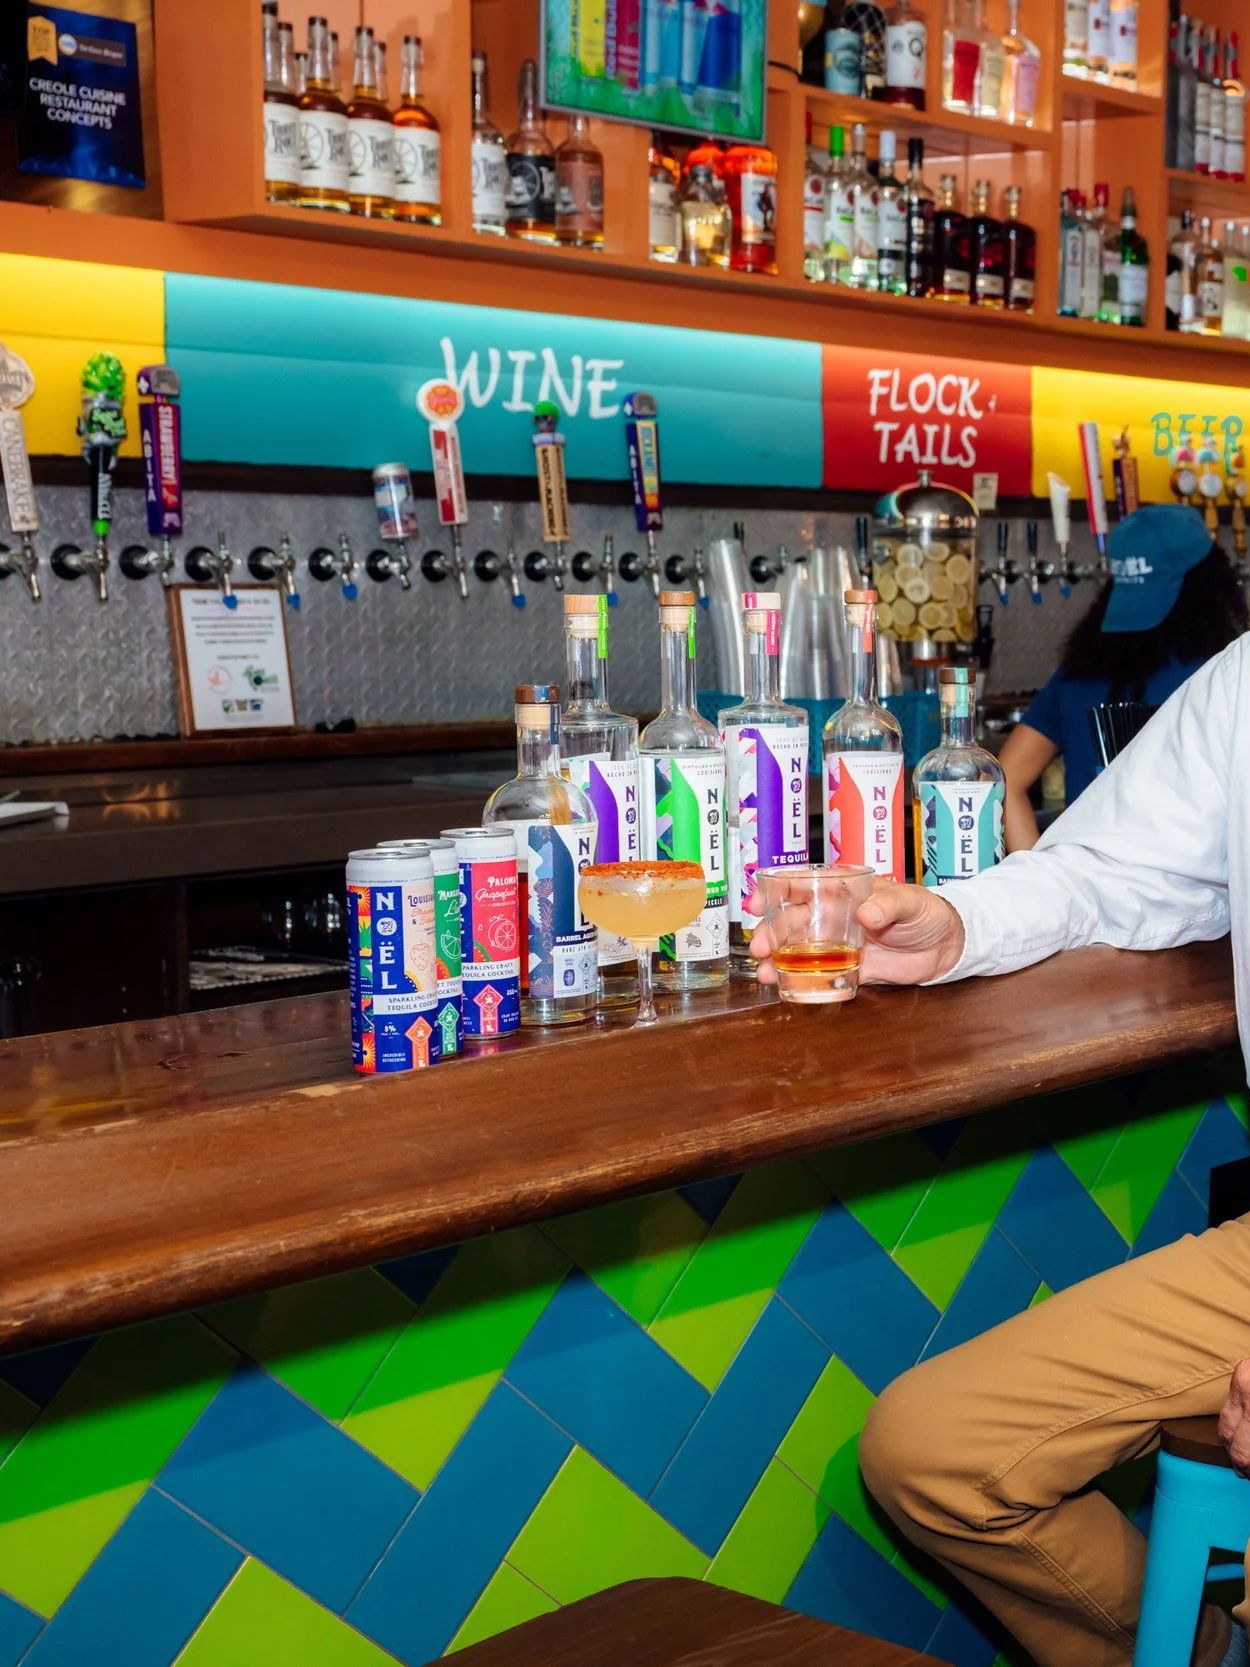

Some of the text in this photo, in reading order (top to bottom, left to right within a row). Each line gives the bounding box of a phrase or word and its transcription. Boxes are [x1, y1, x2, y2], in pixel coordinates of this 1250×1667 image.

[29, 77, 126, 106] CREOLE CUISINE
[40, 93, 117, 117] RESTAURANT
[47, 109, 112, 129] CONCEPTS
[440, 337, 624, 419] WINE
[867, 368, 983, 419] FLOCK
[2, 417, 28, 515] CANEBRAKE
[143, 429, 157, 502] ABITA
[873, 421, 977, 468] TAILS
[790, 757, 802, 839] NOËL
[625, 785, 637, 862] NOË
[707, 788, 719, 871] NOËL
[873, 786, 887, 863] NOËL
[958, 797, 974, 872] NOËL
[375, 892, 397, 989] NOËL
[556, 934, 582, 943] BARREL
[437, 986, 459, 995] OCKTAIL
[462, 963, 495, 971] PARKLING
[387, 1003, 418, 1011] TEQUILA
[388, 994, 425, 1003] SPARKLING
[384, 1025, 397, 1033] 8%
